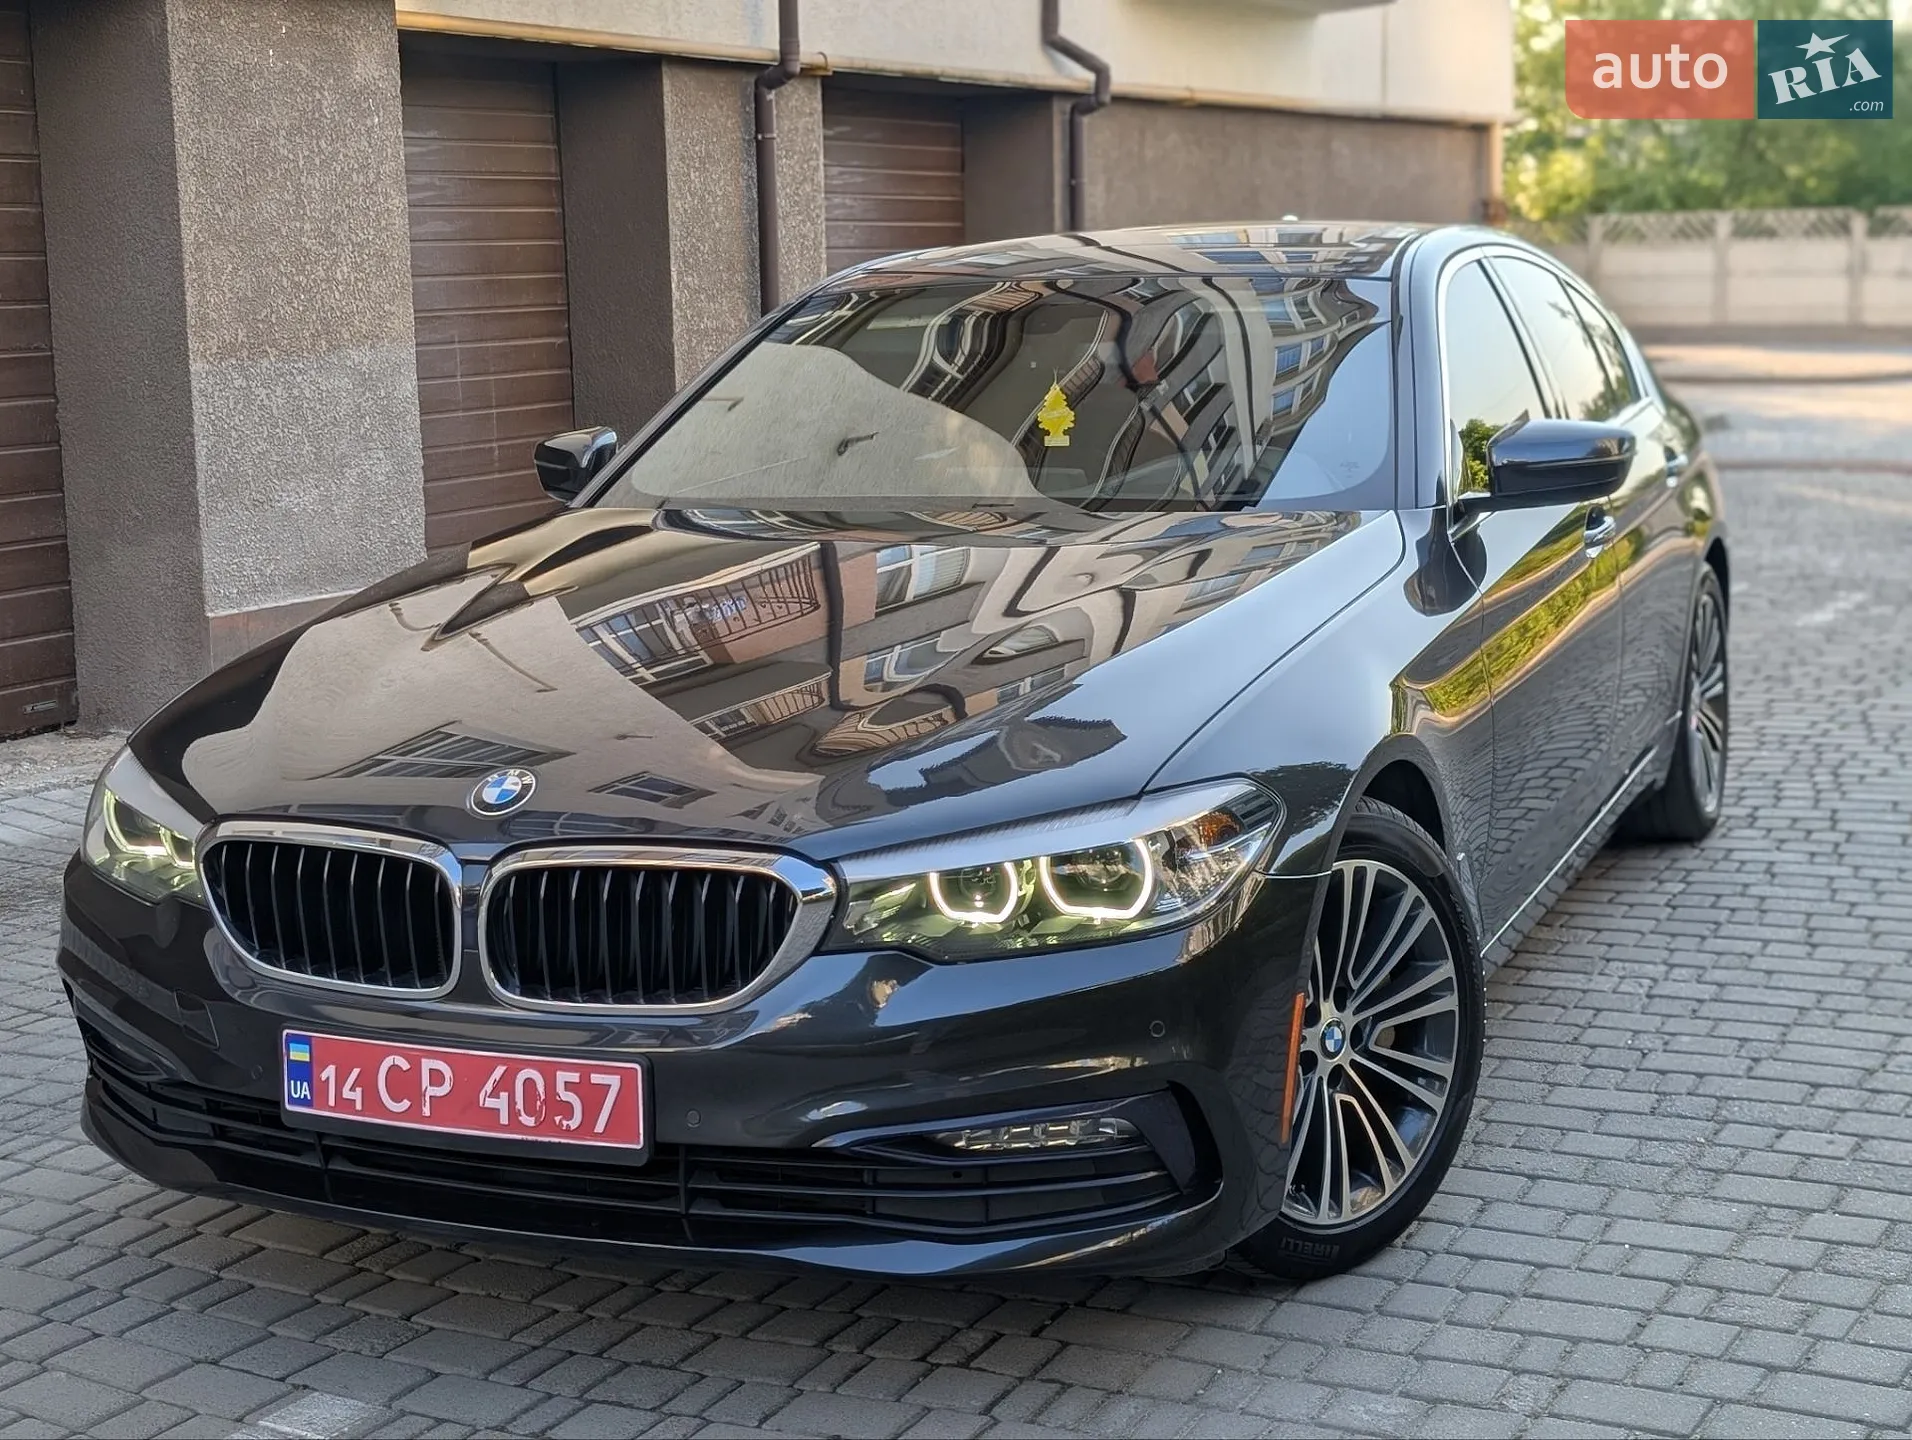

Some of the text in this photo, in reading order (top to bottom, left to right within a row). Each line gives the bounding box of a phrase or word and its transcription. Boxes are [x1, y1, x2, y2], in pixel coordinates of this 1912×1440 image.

[290, 1080, 311, 1100] UA
[319, 1064, 364, 1111] 14
[478, 1064, 622, 1134] 4057
[1279, 1236, 1340, 1263] PIRELLI
